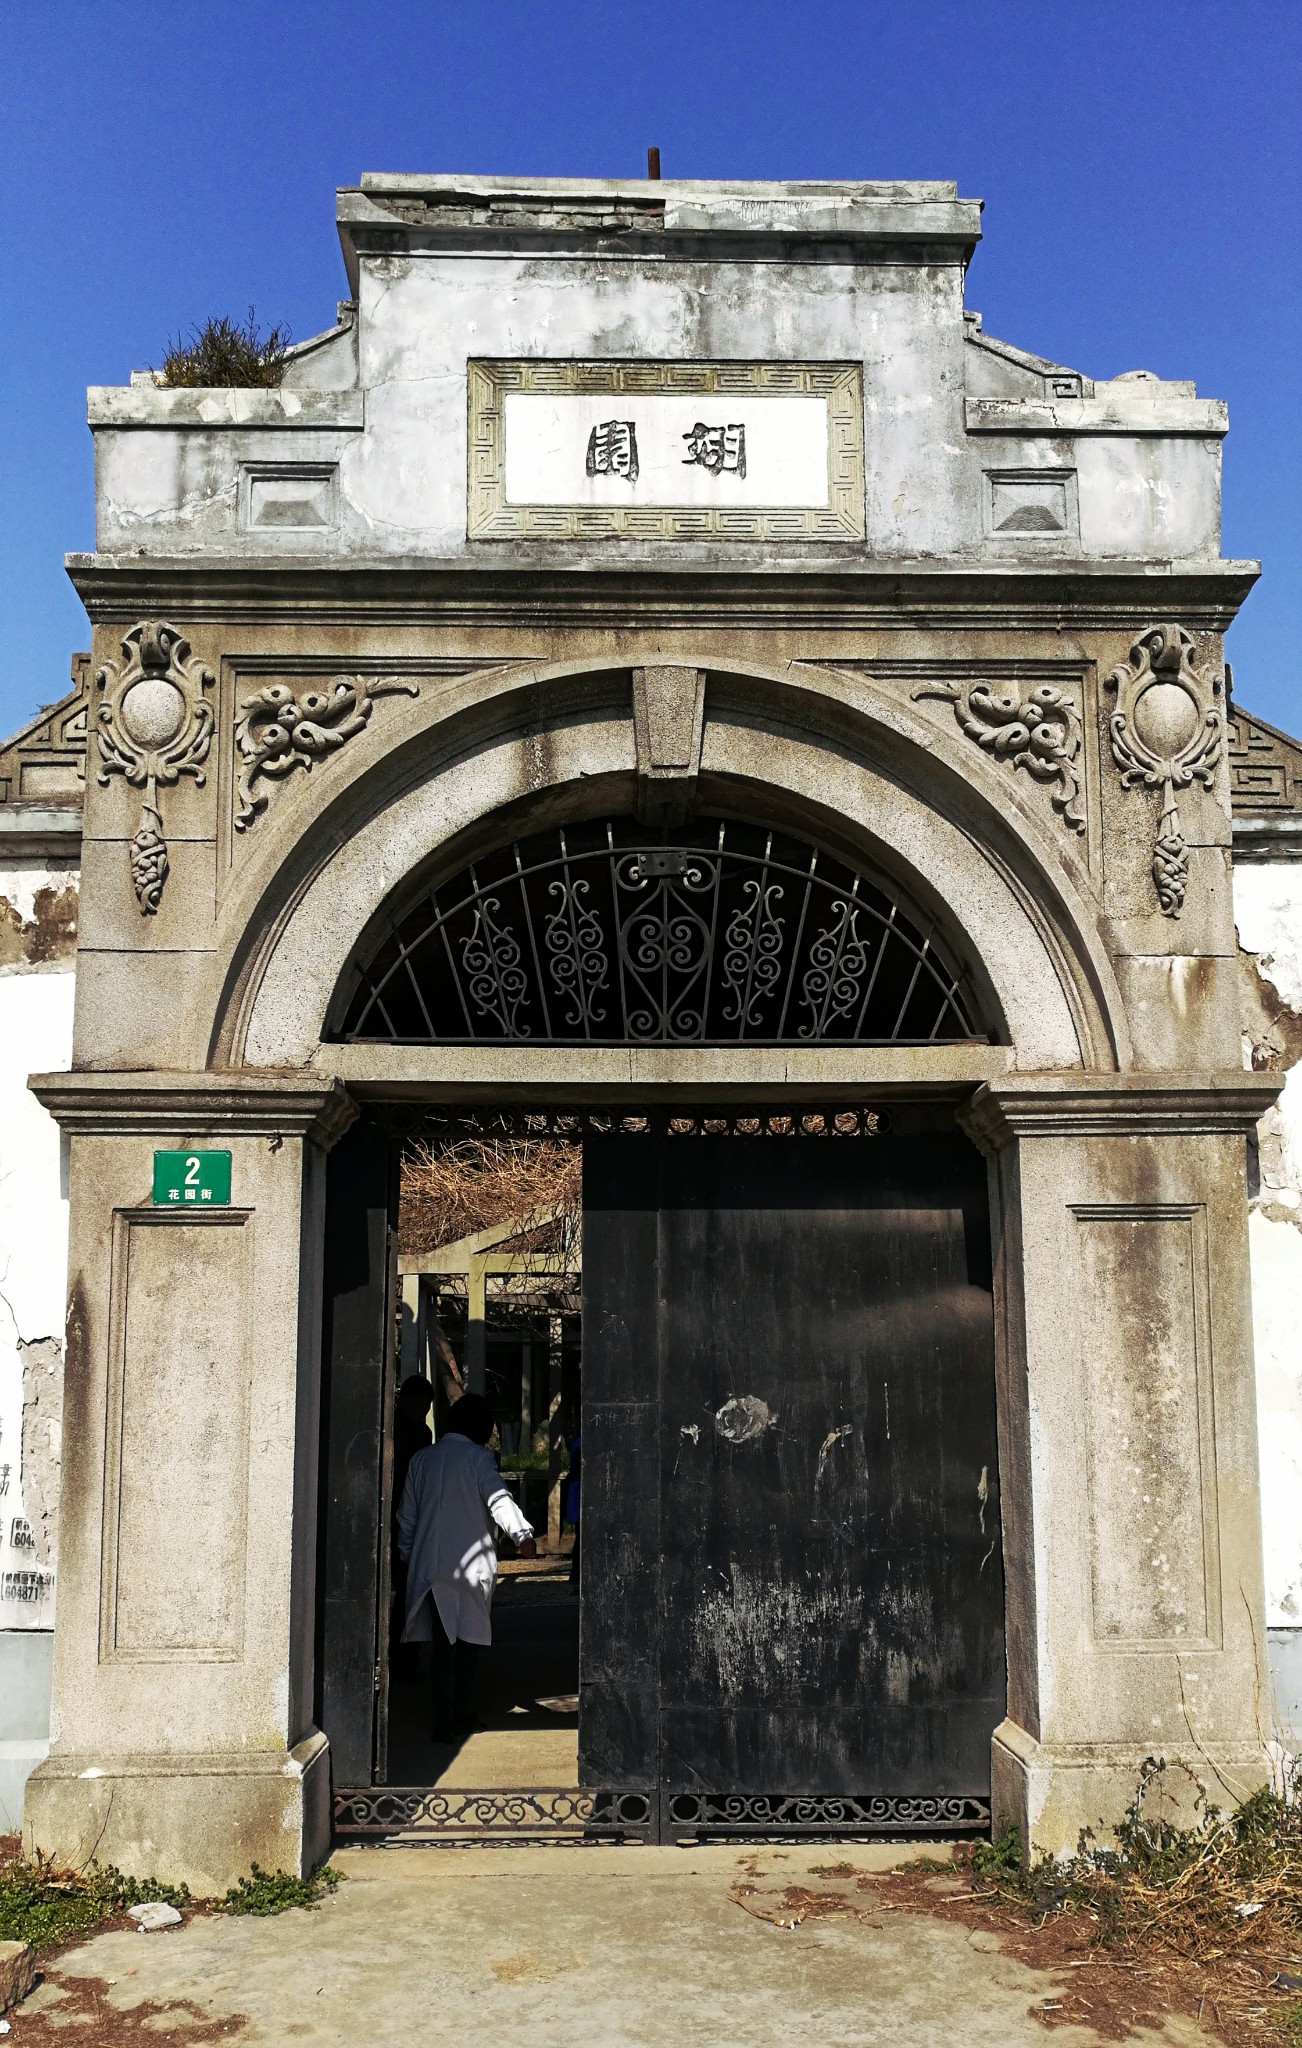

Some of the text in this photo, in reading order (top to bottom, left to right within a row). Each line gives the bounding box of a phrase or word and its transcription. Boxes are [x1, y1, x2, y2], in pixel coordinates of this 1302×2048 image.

[184, 1157, 200, 1185] 2
[168, 1189, 212, 1200] 花园街
